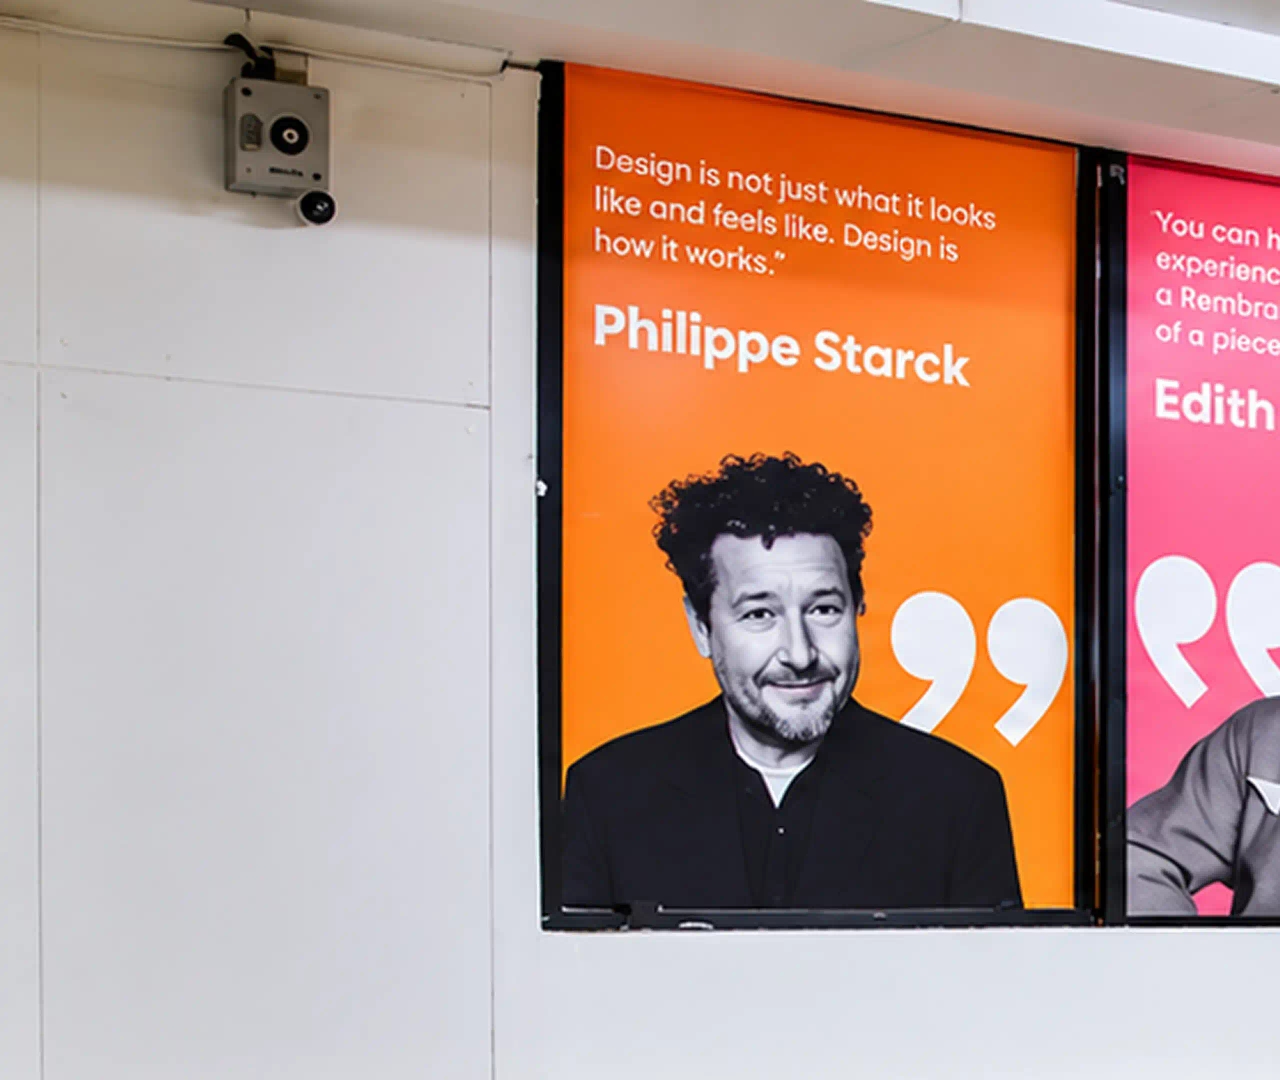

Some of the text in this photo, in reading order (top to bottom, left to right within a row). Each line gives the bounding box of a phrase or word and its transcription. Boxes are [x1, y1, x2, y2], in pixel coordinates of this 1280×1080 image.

[596, 145, 997, 230] Design is not just what it looks
[595, 186, 959, 262] like and feels like. Design is
[595, 228, 654, 259] how
[661, 238, 678, 262] it
[1155, 210, 1204, 239] You
[1211, 223, 1259, 248] can
[1156, 288, 1171, 305] a
[594, 304, 970, 387] Philippe Starck
[1156, 322, 1181, 343] of
[1188, 328, 1203, 346] a
[1155, 379, 1274, 431] Edith
